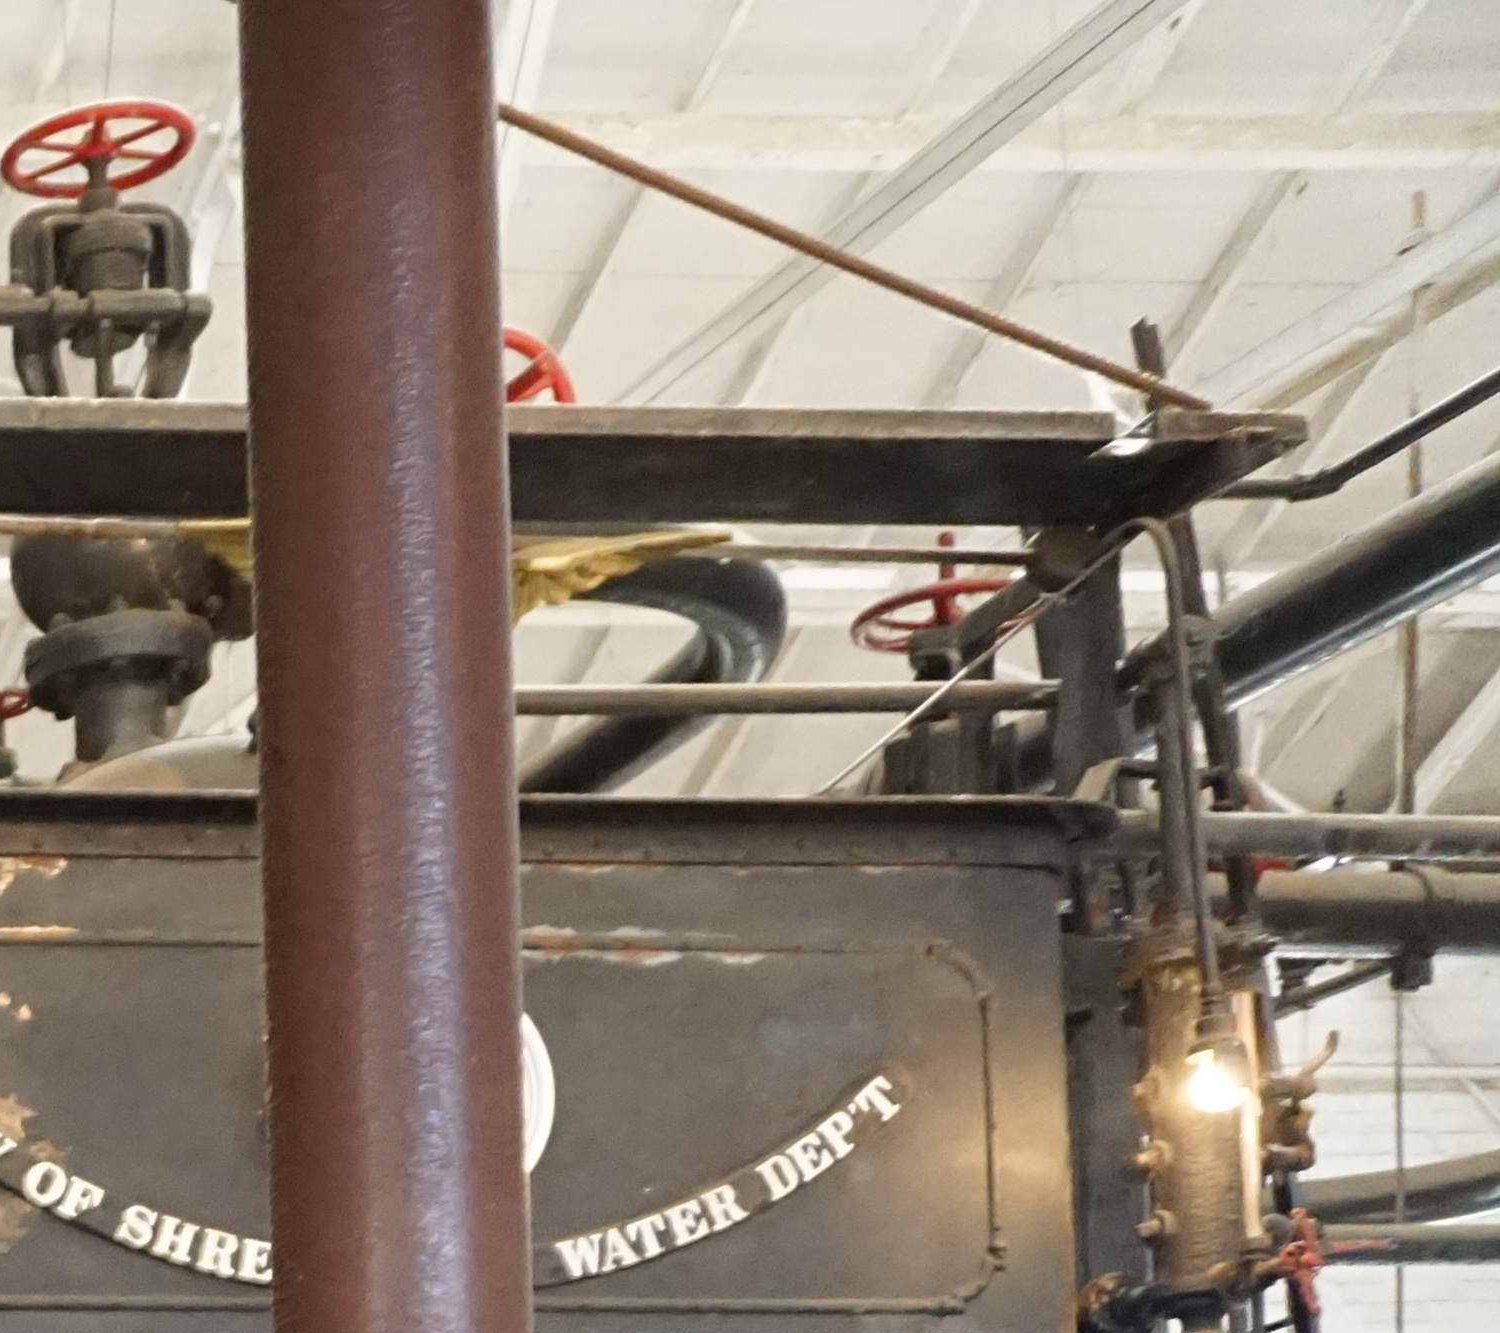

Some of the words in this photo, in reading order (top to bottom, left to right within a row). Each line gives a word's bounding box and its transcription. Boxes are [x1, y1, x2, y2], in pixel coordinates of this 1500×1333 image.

[21, 1160, 105, 1220] OF
[114, 1204, 274, 1286] SHRE
[554, 1184, 750, 1280] WATER
[754, 1075, 902, 1202] DEP'T
